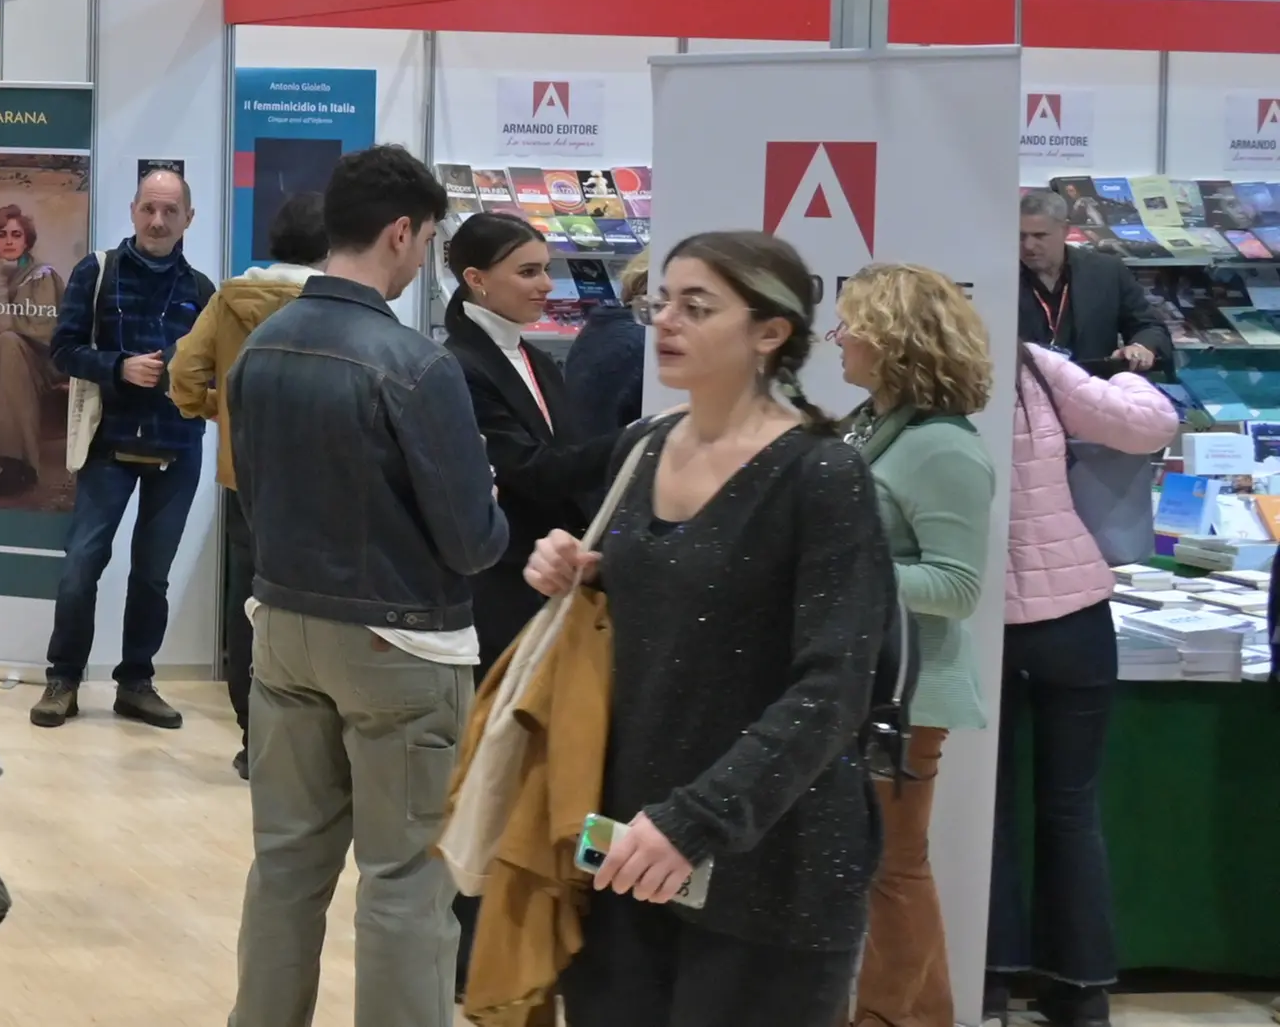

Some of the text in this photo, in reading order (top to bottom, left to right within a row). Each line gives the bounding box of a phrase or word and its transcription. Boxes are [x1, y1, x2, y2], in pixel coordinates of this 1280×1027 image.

[270, 82, 300, 91] Antonio
[244, 100, 356, 113] Il femminicidio in Italia
[503, 124, 599, 135] ARMANDO EDITORE
[1020, 135, 1088, 147] ANDO EDITORE
[1230, 140, 1277, 150] ARMANDO
